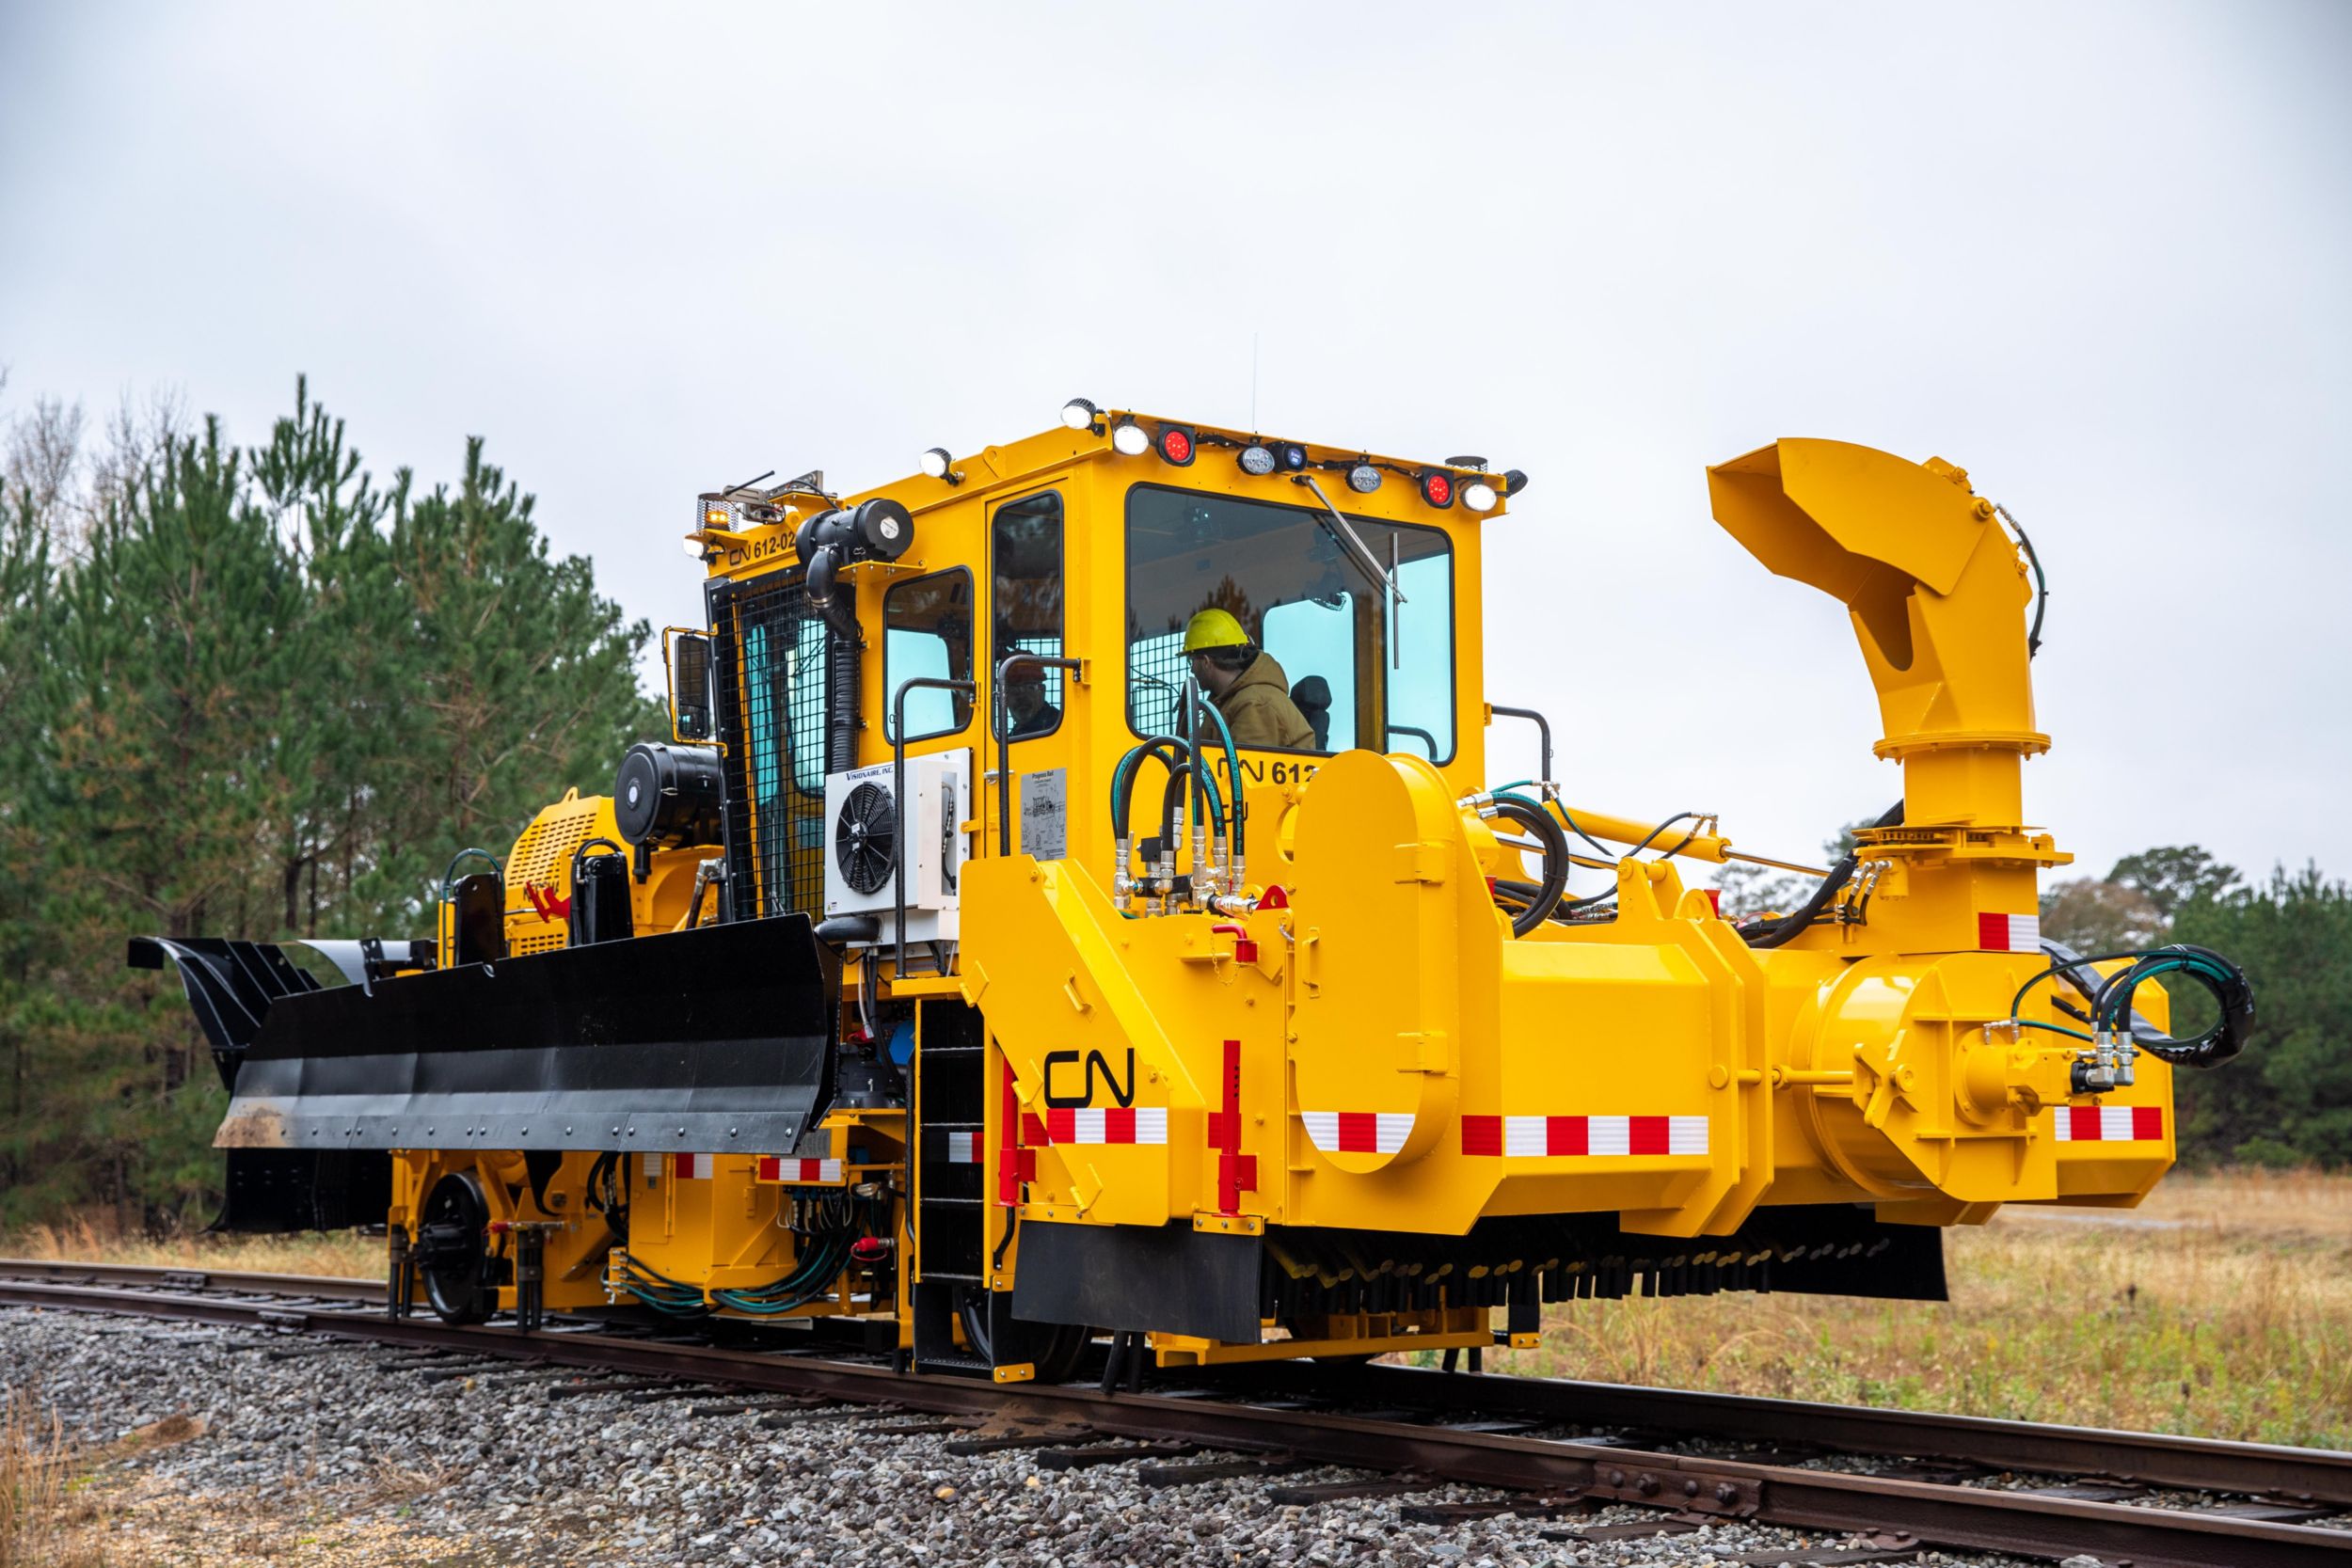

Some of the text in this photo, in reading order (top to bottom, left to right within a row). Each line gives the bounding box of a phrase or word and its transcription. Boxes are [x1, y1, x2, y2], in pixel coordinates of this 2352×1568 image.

[729, 531, 797, 566] CN 612-02
[1043, 1047, 1135, 1109] CN
